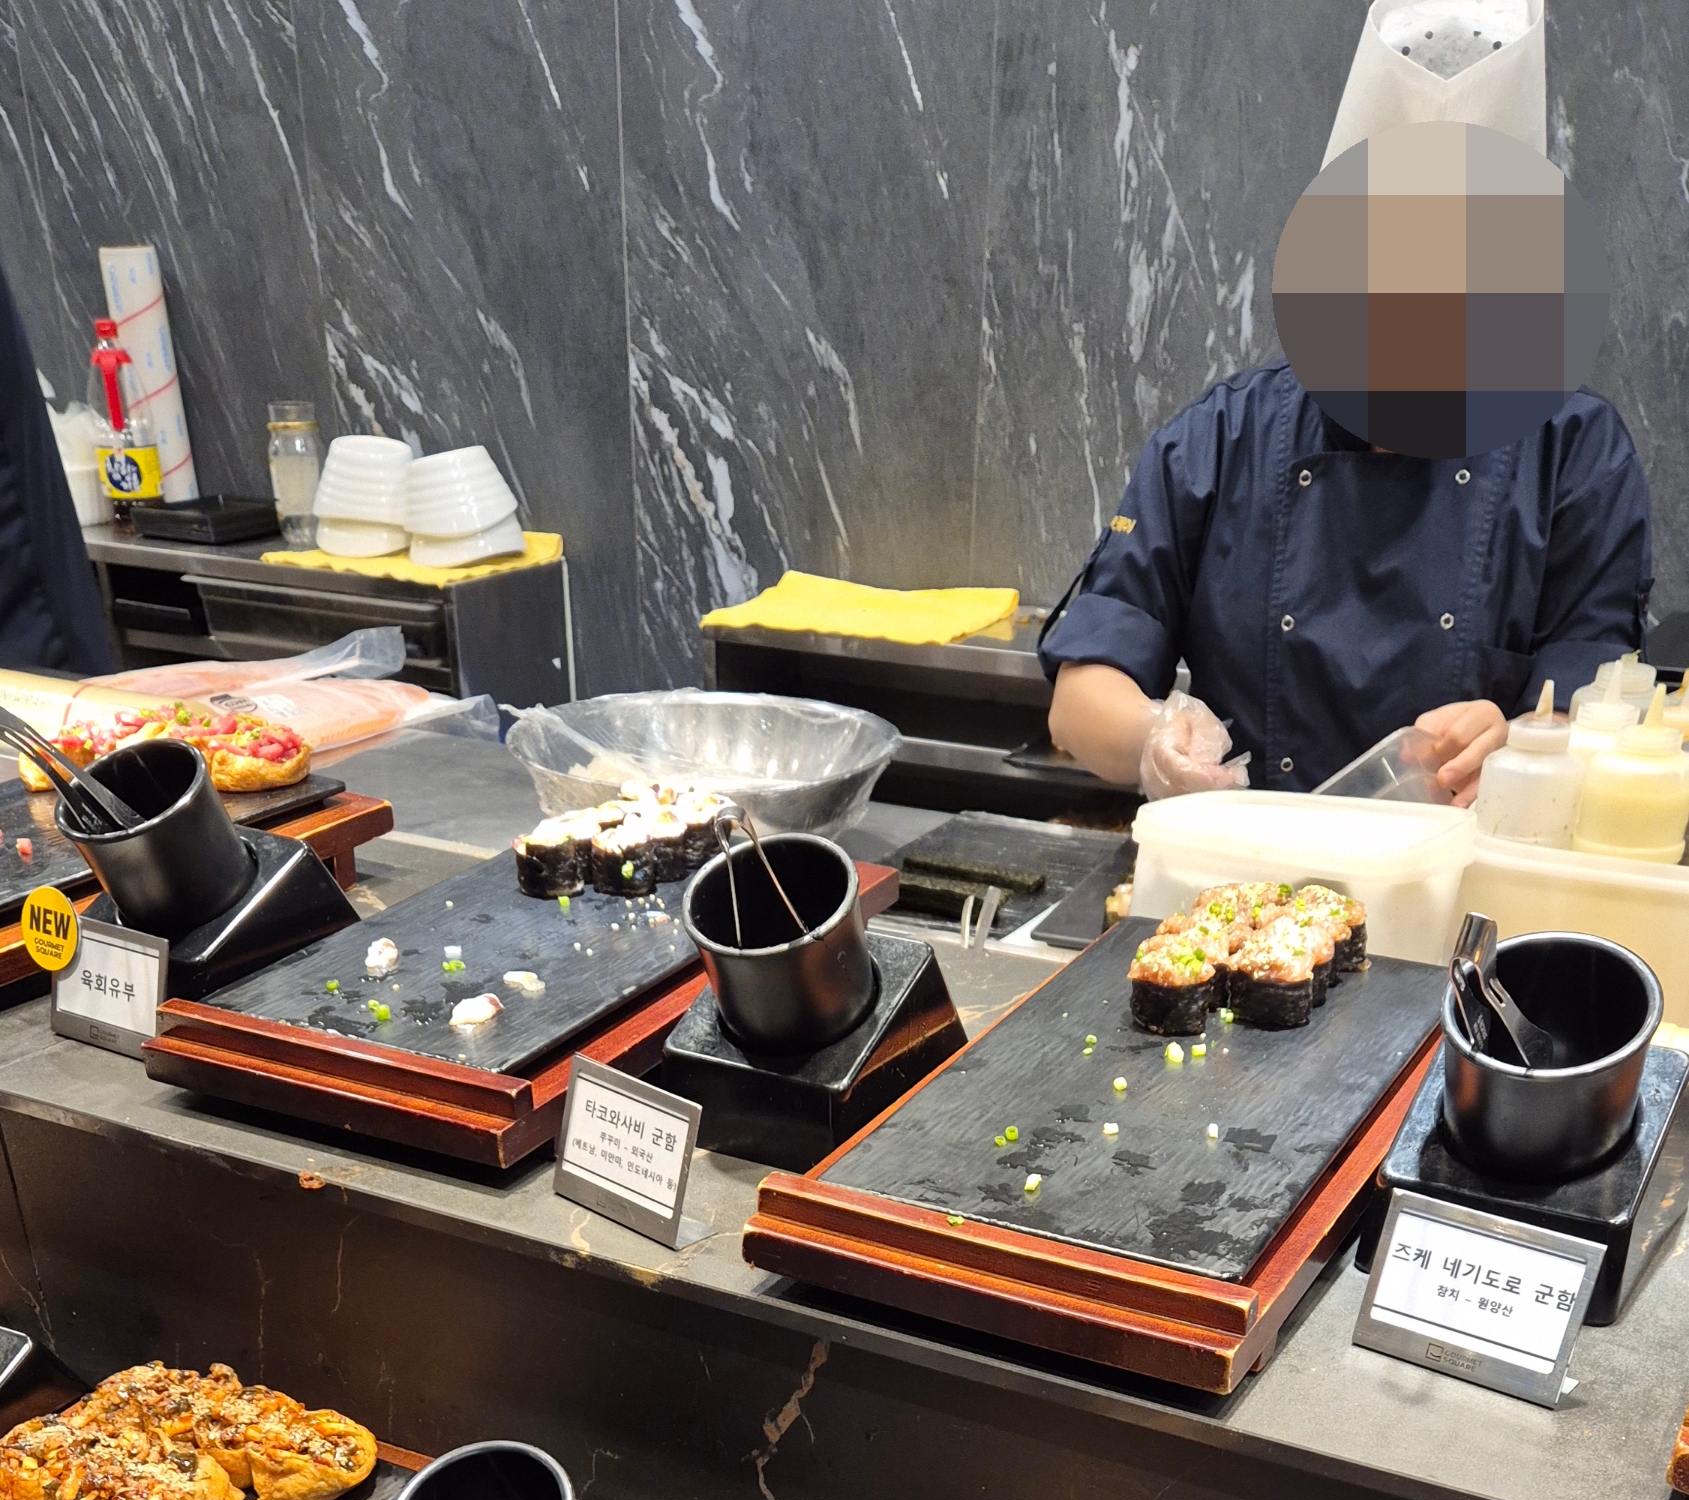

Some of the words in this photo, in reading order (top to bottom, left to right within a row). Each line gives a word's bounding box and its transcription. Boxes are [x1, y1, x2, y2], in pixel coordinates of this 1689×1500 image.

[29, 904, 71, 941] NEW
[34, 937, 65, 953] GOURMET
[35, 945, 63, 960] SQUARE
[81, 969, 136, 1002] 육회유부
[585, 1099, 645, 1140] 타코와사비
[651, 1127, 678, 1153] 군함
[631, 1145, 654, 1164] 외국산
[627, 1160, 664, 1186] 인도네시아
[666, 1177, 677, 1193] 등)
[1392, 1242, 1433, 1270] 즈케
[1442, 1256, 1522, 1296] 네기도로
[1534, 1283, 1576, 1313] 군함
[1436, 1284, 1460, 1302] 참치
[1478, 1296, 1514, 1318] 원양산
[1442, 1356, 1477, 1373] SQUARE
[1444, 1350, 1484, 1367] GOURMET
